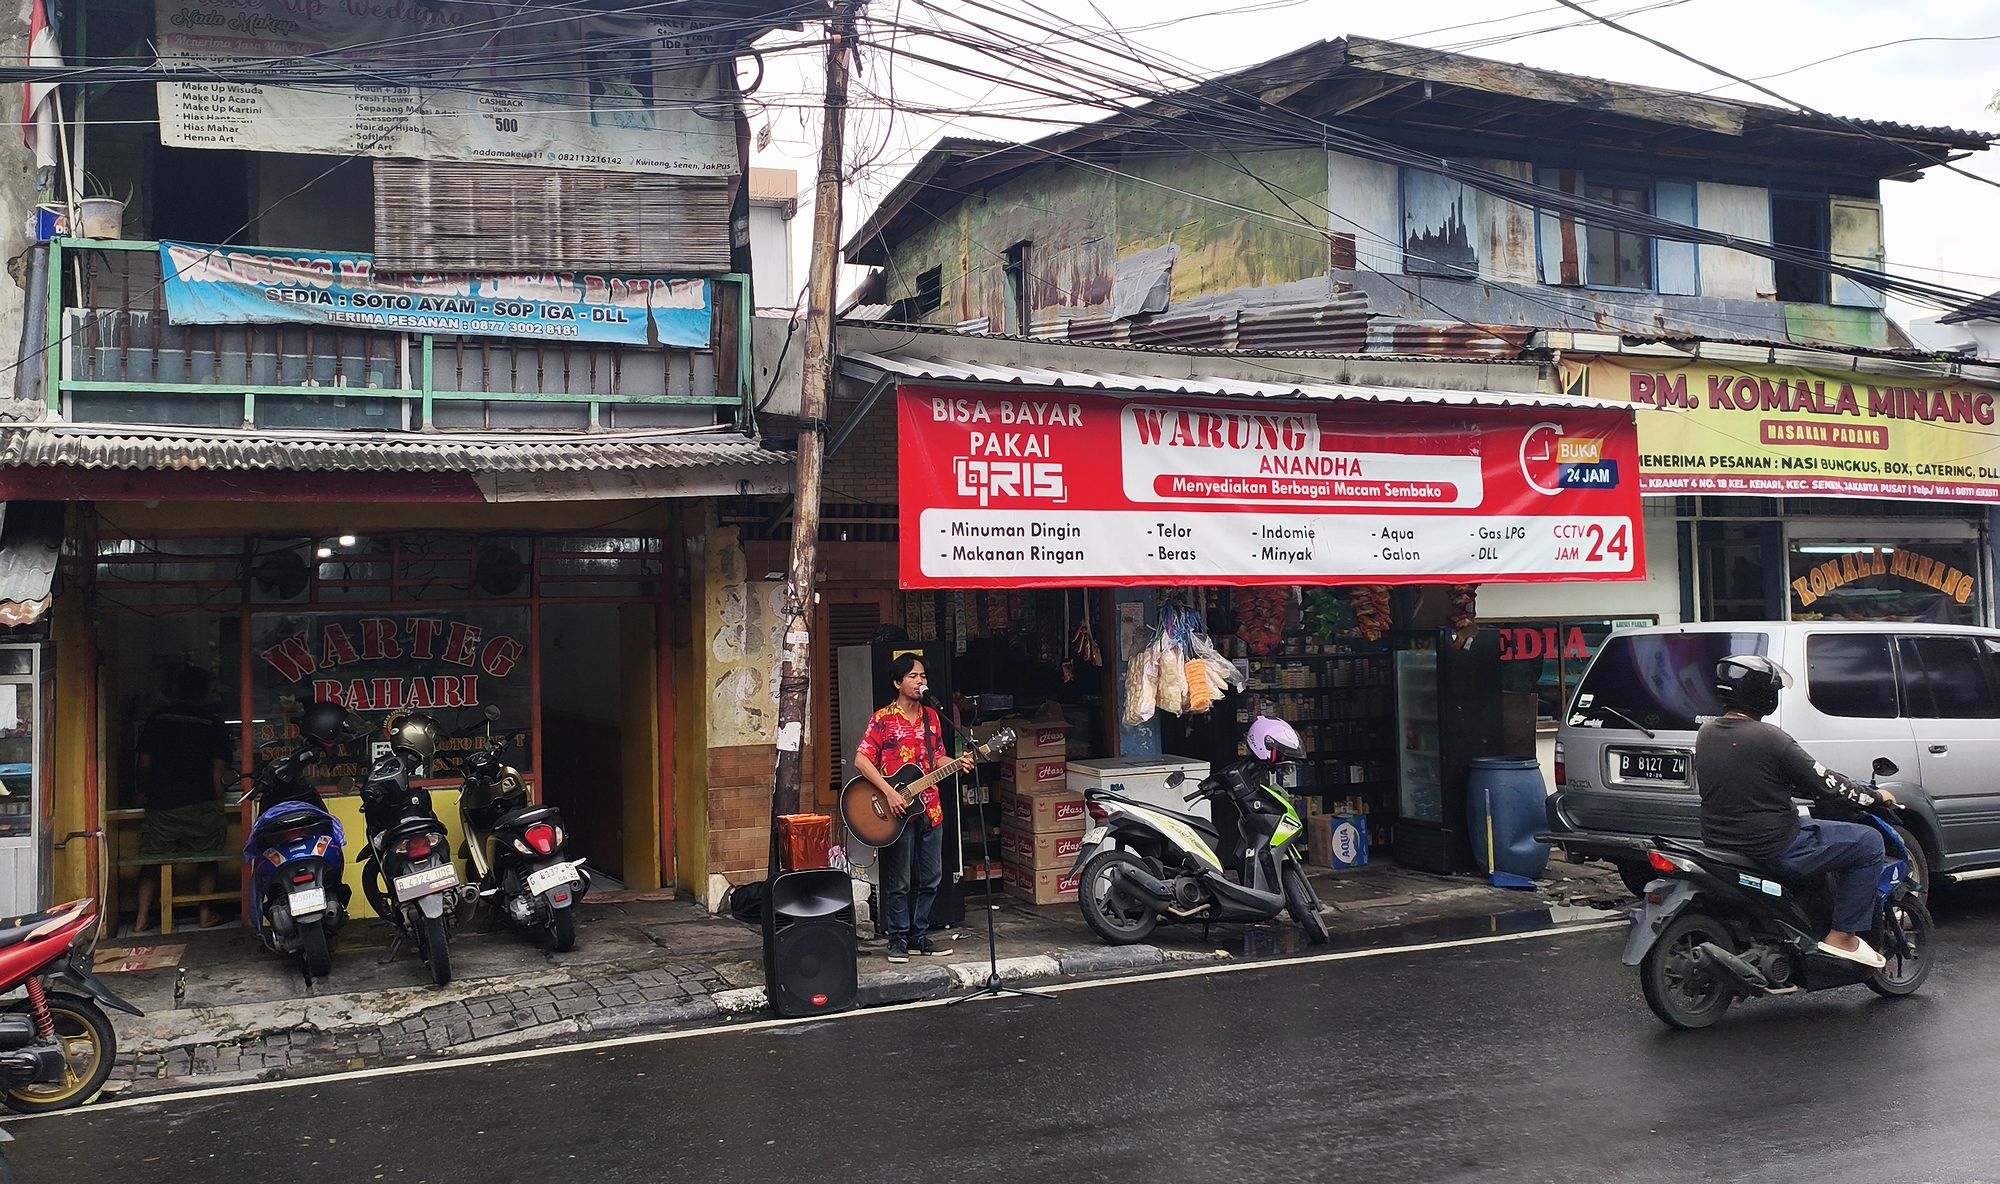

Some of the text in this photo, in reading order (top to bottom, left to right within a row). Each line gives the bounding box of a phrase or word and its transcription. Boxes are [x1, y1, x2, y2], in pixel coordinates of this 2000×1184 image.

[171, 8, 226, 29] Nada
[182, 82, 209, 92] Make
[211, 83, 225, 94] Up
[226, 85, 264, 95] Wisuda
[182, 92, 256, 105] Make Up Acara
[383, 95, 414, 104] Flower
[479, 97, 524, 108] CASHBACK
[182, 102, 263, 115] Make Up Kartini
[354, 104, 404, 116] (Sepasang
[183, 122, 240, 134] Hias Mahar
[495, 117, 519, 133] 500
[183, 133, 235, 143] Henna Art
[377, 143, 394, 152] Art
[473, 147, 543, 161] nadamakeup11
[557, 152, 622, 165] 082113216142
[266, 288, 630, 325] SEDIA SOTO AYAM SOP IGA DLL
[325, 310, 579, 337] TERIMA PESANAN 0877 3002 8181
[1629, 370, 1996, 426] RM. KOMALA MINANG
[931, 397, 1084, 428] BISA BAYAR
[1131, 408, 1307, 452] WARUNG
[1767, 424, 1881, 448] MASAKAN PADANG
[970, 431, 1051, 459] PAKAI
[1560, 443, 1599, 459] BUKA
[1259, 454, 1363, 478] ANANDHA
[1710, 455, 1772, 472] PESANAN
[1782, 457, 1818, 470] NASI
[1820, 459, 1882, 475] BUNGKUS,
[1884, 463, 1913, 477] BOX,
[1915, 464, 1976, 479] CATERING,
[957, 460, 1064, 508] QRIS
[1566, 468, 1610, 484] 24 JAM
[1172, 477, 1443, 500] Menyediakan Berbagai Macam Sembako
[1648, 478, 1690, 488] KRAMAT
[1728, 479, 1749, 489] KEL.
[1786, 480, 1810, 490] KEC.
[1880, 484, 1907, 494] PUSAT
[951, 522, 1082, 541] Minuman Dingin
[1156, 522, 1193, 538] Telor
[1261, 525, 1316, 540] Indomie
[1381, 526, 1415, 547] Aqua
[1478, 527, 1527, 541] Gas LPG
[1553, 524, 1586, 540] CCTV
[1585, 523, 1629, 563] 24
[953, 545, 1085, 565] Makanan Ringan
[1158, 546, 1197, 561] Beras
[1261, 547, 1313, 565] Minyak
[1381, 547, 1421, 562] Galon
[1478, 547, 1499, 562] DLL
[1554, 546, 1580, 562] JAM
[1791, 547, 1975, 607] KOMALA MINANG
[260, 617, 525, 684] WARTEG
[312, 674, 480, 712] BAHARI
[1039, 731, 1065, 744] Hass
[1622, 755, 1630, 770] B
[1638, 756, 1664, 772] 8127
[1039, 765, 1065, 779] Hass
[1057, 804, 1083, 818] Hass
[1340, 828, 1351, 858] AQUA
